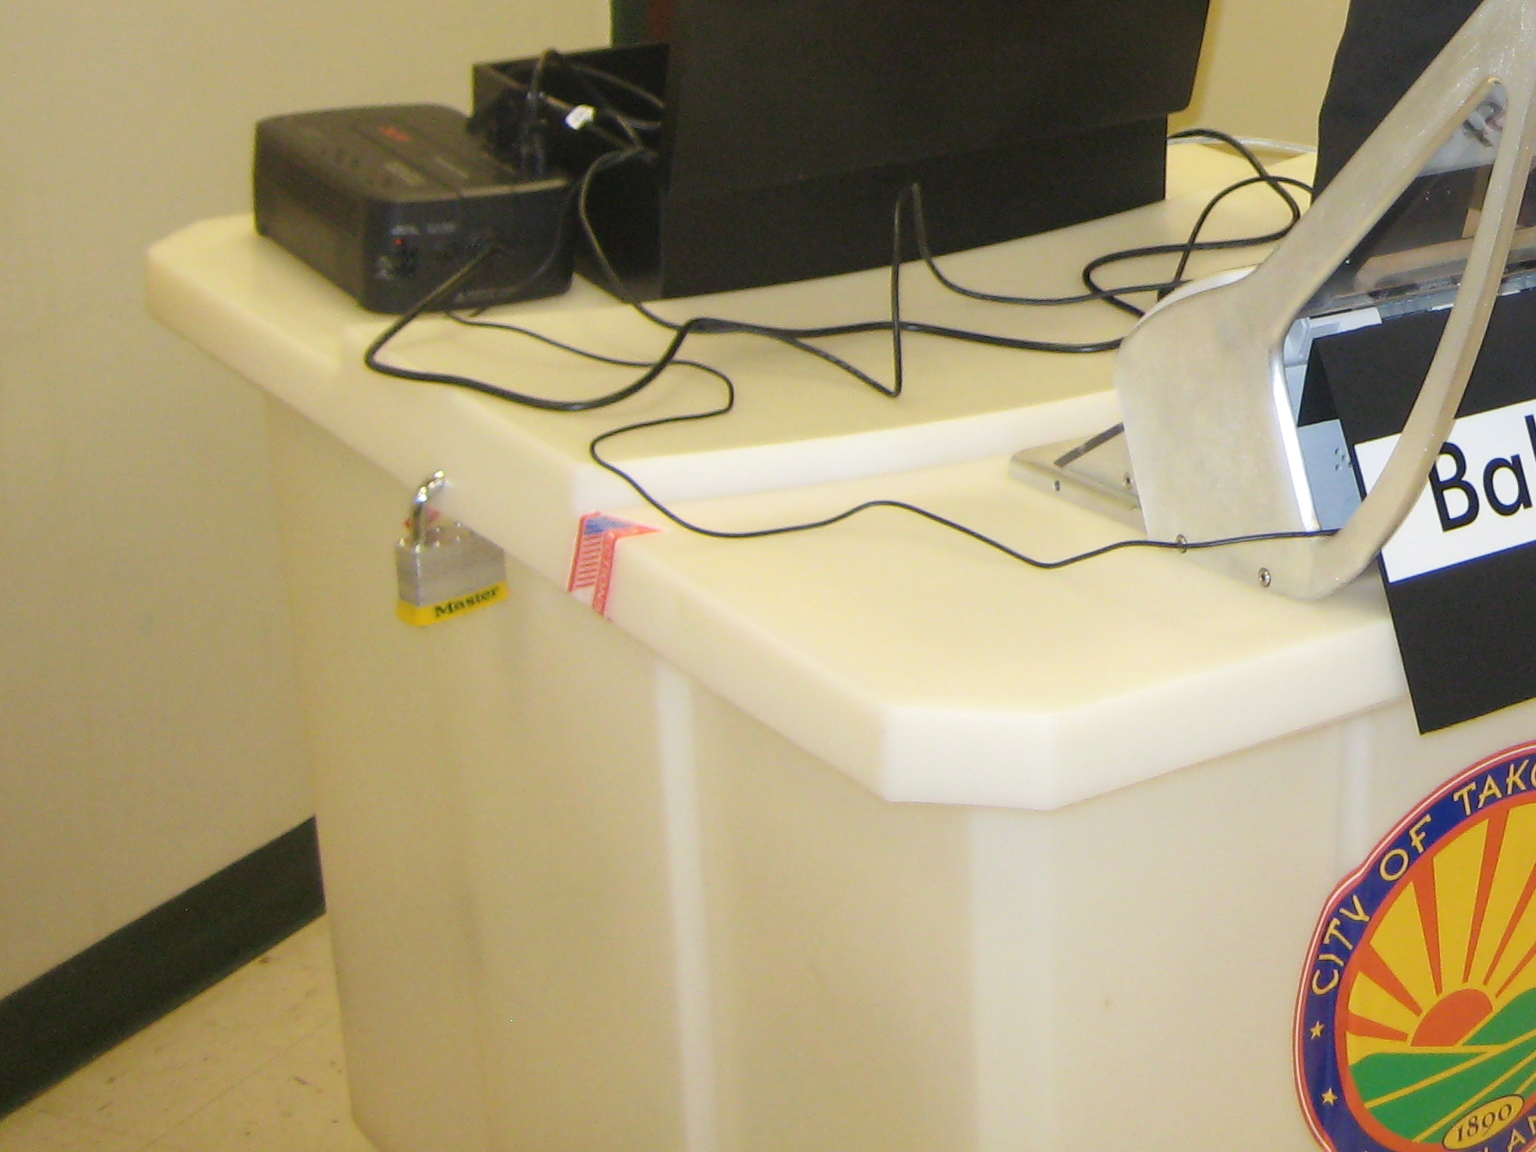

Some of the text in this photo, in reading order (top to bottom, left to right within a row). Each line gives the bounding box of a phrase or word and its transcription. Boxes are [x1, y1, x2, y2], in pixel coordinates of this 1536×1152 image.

[435, 586, 500, 618] Master
[1311, 895, 1371, 997] CITY
[1379, 814, 1433, 882] OF
[1456, 1103, 1513, 1142] 1890
